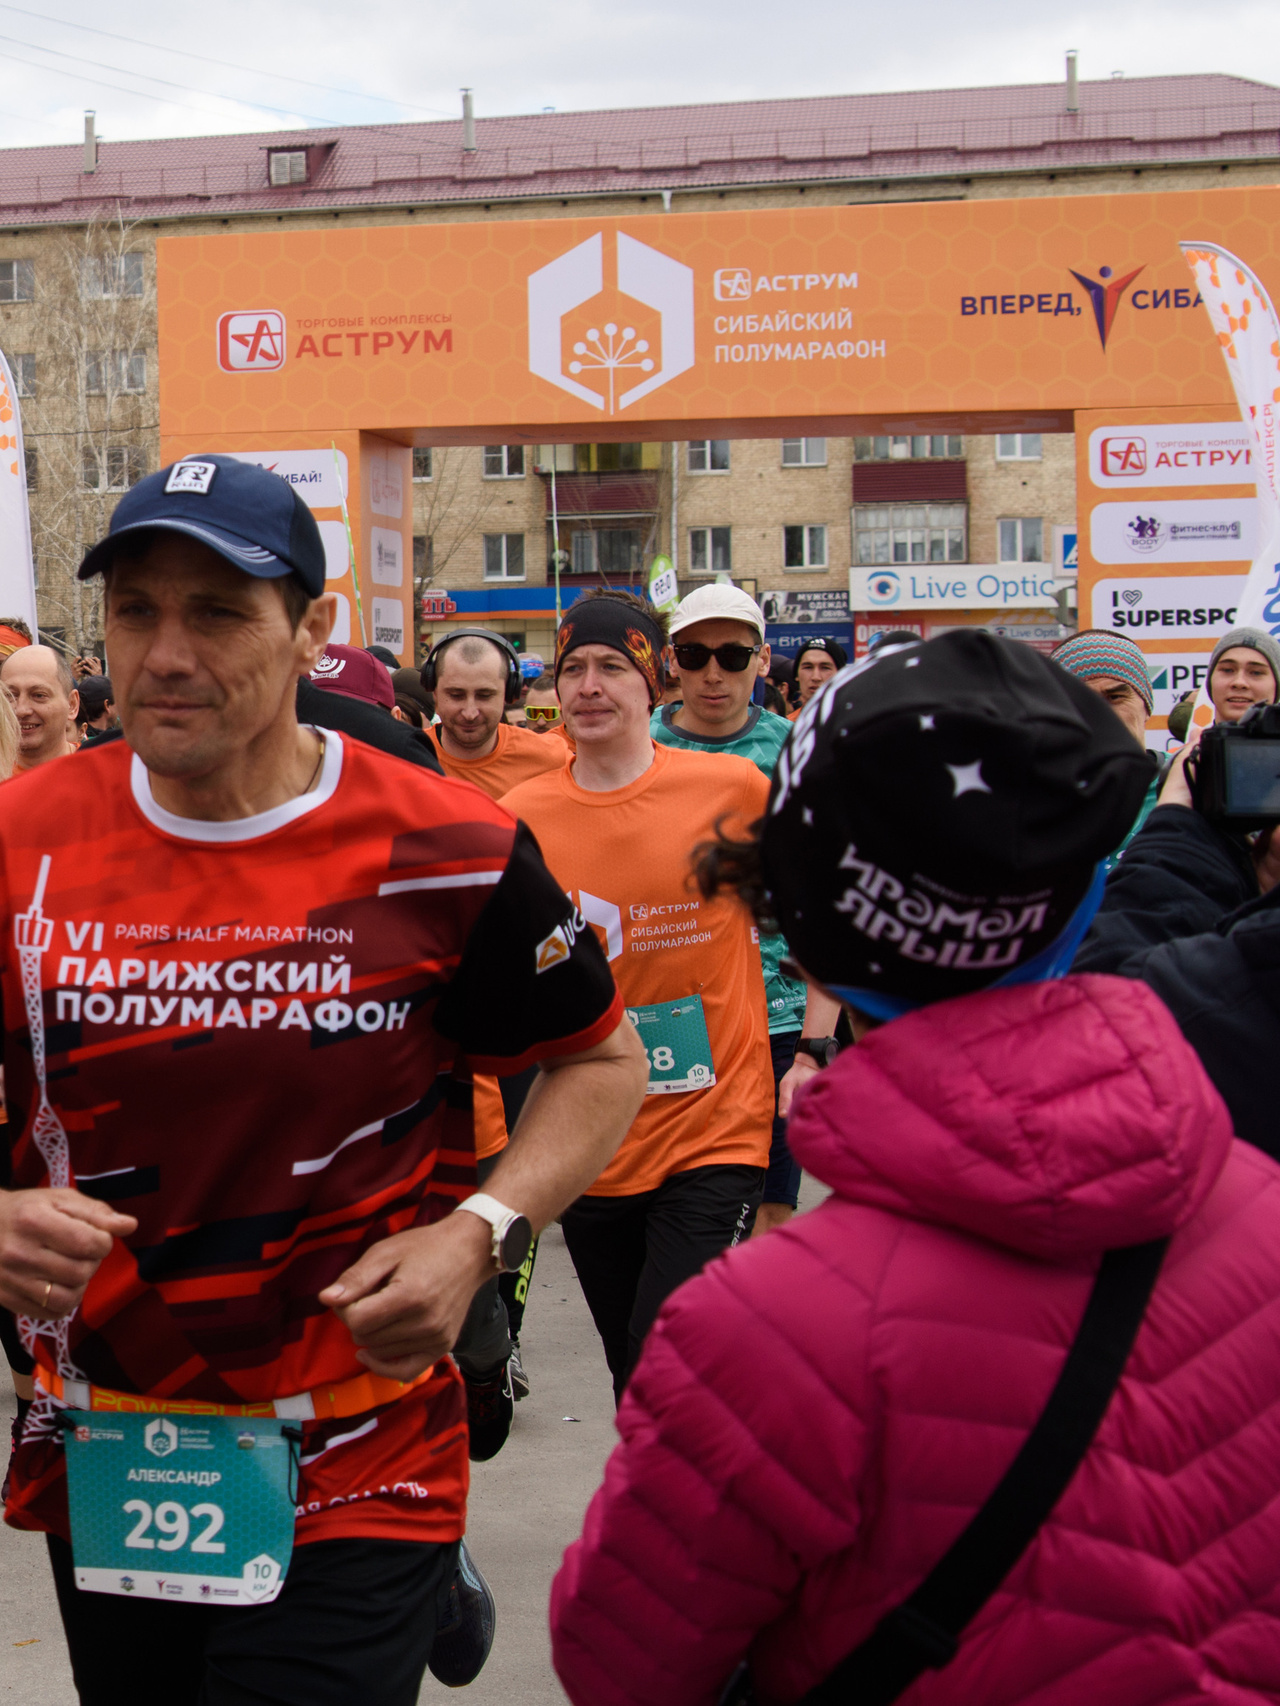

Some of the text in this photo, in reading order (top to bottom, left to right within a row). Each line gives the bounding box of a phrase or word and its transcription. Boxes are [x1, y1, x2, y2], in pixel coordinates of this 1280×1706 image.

[754, 271, 858, 292] АСТРУМ
[959, 287, 1205, 317] ВПЕРЕД, СИБА
[297, 313, 452, 329] ТОРГОВЫЕ КОМПЛЕКСЫ
[713, 306, 852, 334] СИБАЙСКИЙ
[295, 329, 453, 358] АСТРУМ
[714, 338, 886, 363] ПОЛУМАРАФОН
[1155, 439, 1203, 449] ТОРГОВЫЕ
[279, 470, 322, 484] ИБАЙ!
[1170, 522, 1238, 535] фитнес-клуб
[1131, 538, 1159, 546] BODY
[797, 592, 848, 601] МУЖСКАЯ
[911, 577, 967, 598] Live
[422, 598, 457, 614] ИТЬ
[809, 601, 848, 610] ОДЕЖДА
[1112, 591, 1118, 607] I
[1112, 608, 1237, 628] SUPERSPO
[1010, 628, 1032, 637] Live
[1172, 665, 1208, 689] РЕ
[650, 901, 699, 916] АСТРУМ
[64, 920, 353, 951] VI PARIS HALF MARATHON
[631, 919, 697, 938] СИБАЙСКИЙ
[631, 930, 712, 952] ПОЛУМАРАФОН
[56, 954, 352, 994] ПАРИЖСКИЙ
[56, 990, 412, 1033] ПОЛУМАРАФОН
[692, 1067, 704, 1077] 10
[126, 1468, 222, 1487] АЛЕКСАНДР
[122, 1499, 226, 1554] 292
[253, 1563, 272, 1579] 10
